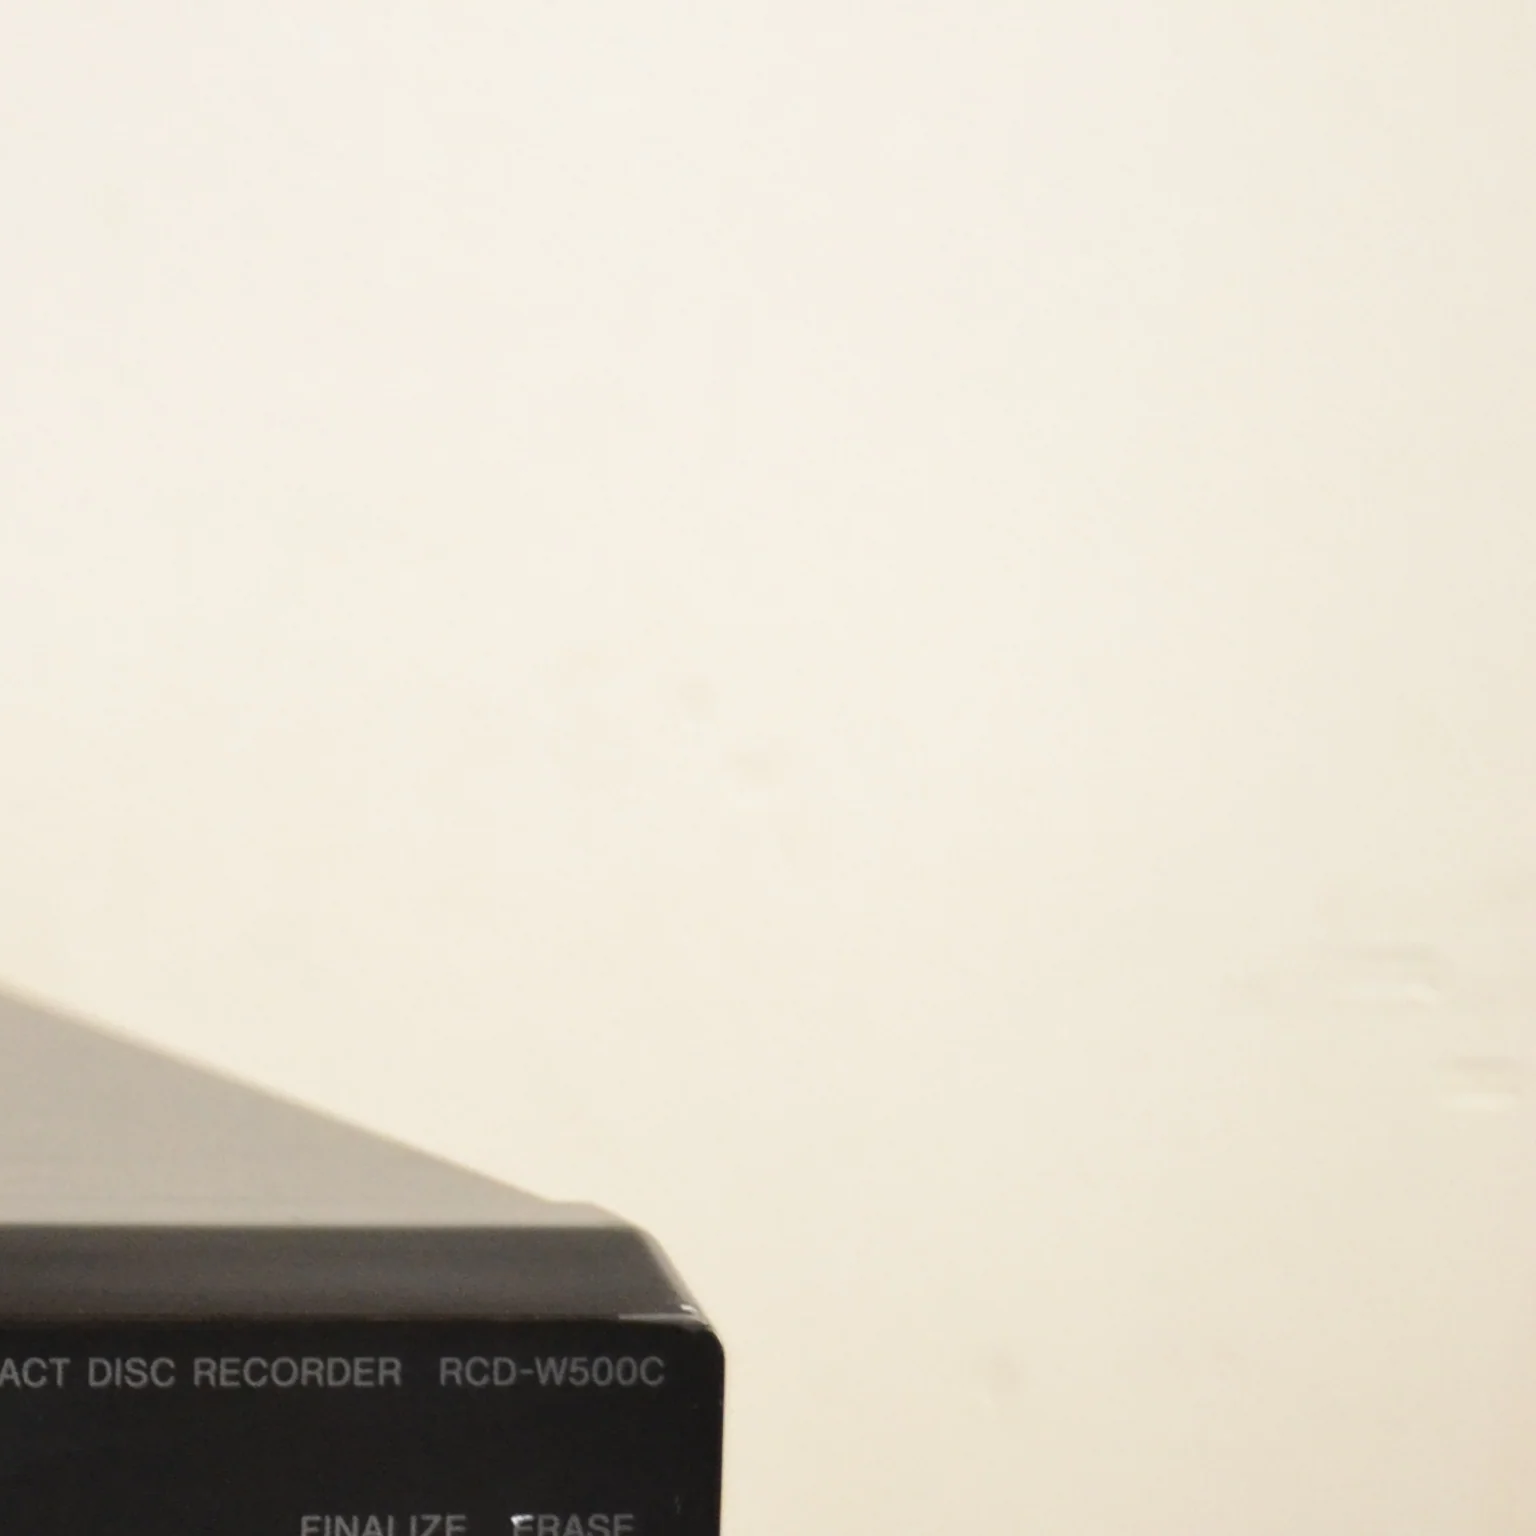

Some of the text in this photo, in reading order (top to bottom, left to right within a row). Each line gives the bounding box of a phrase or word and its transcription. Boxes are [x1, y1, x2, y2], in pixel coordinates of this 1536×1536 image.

[88, 1357, 176, 1387] DISC
[194, 1357, 401, 1387] RECORDER
[440, 1356, 665, 1386] RCD-W500C
